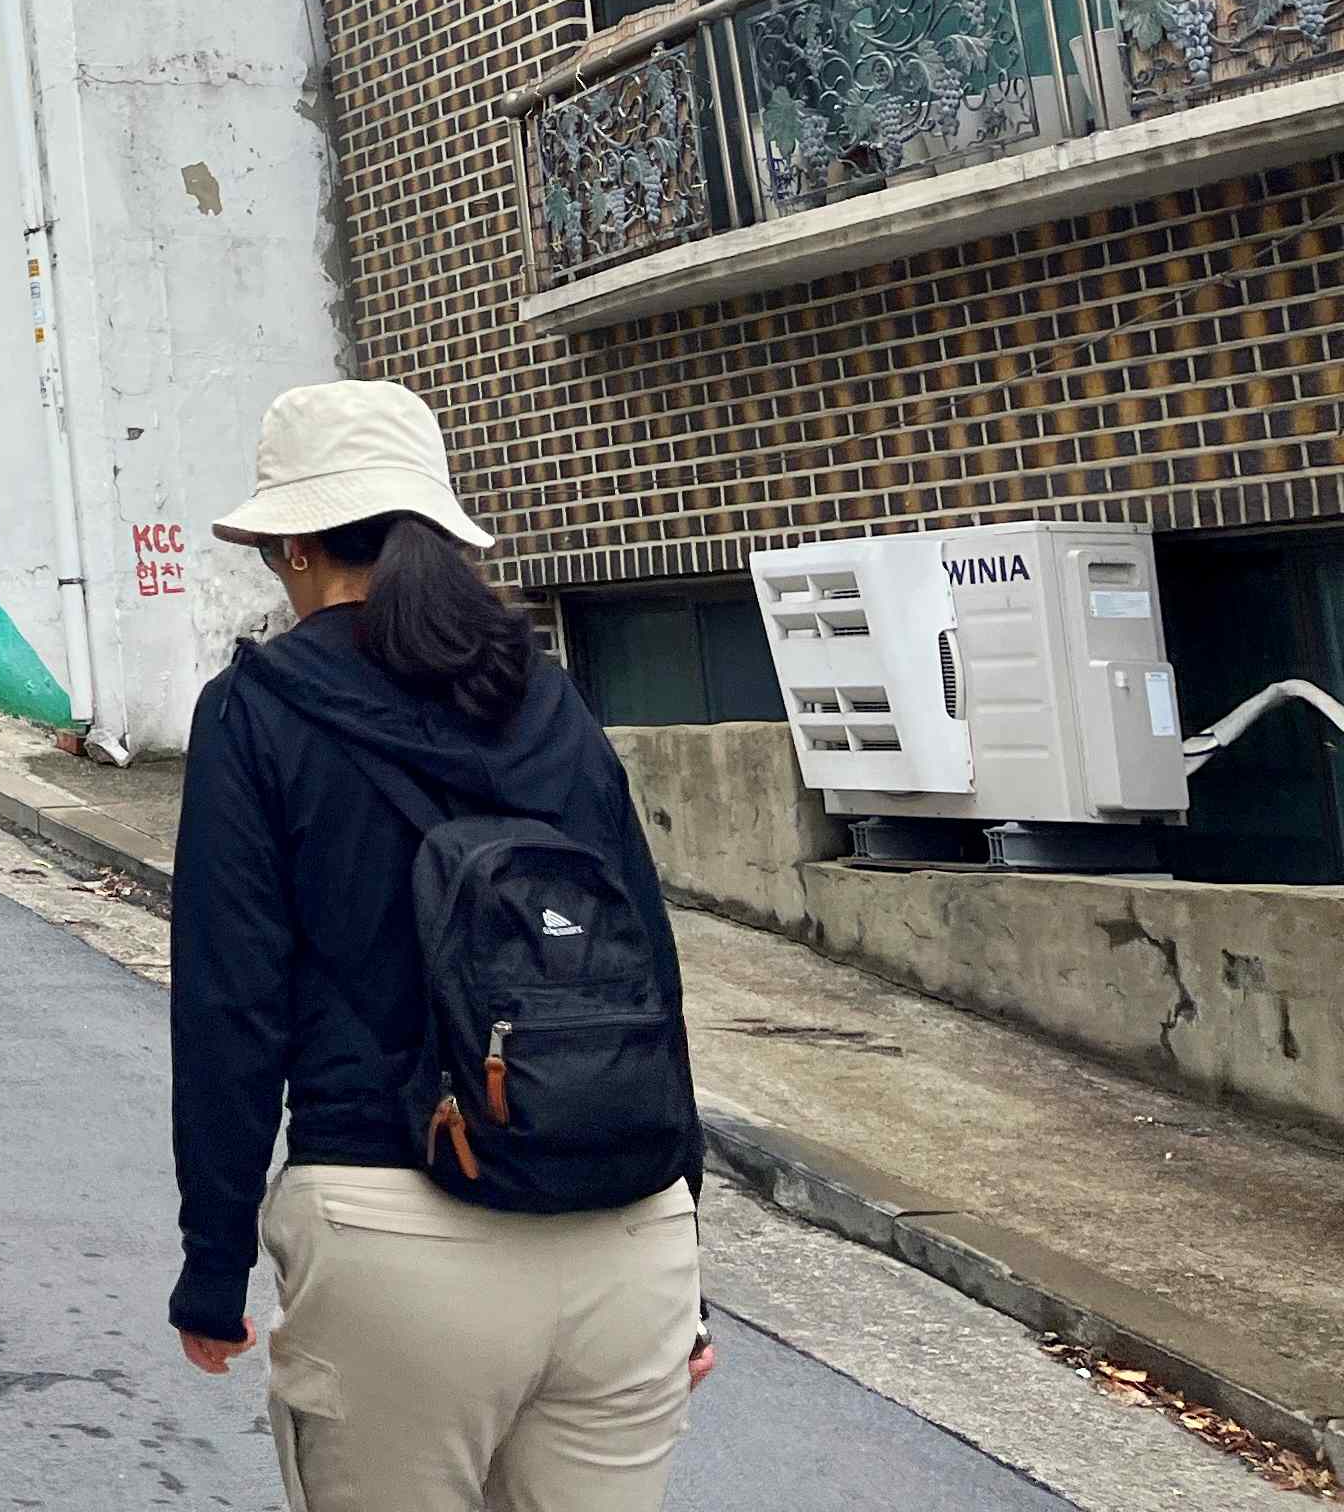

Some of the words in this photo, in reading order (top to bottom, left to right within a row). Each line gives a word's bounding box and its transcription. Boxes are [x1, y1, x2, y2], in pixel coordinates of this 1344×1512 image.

[132, 524, 185, 553] KCC
[136, 561, 185, 596] 협찬
[942, 554, 1031, 586] WINIA
